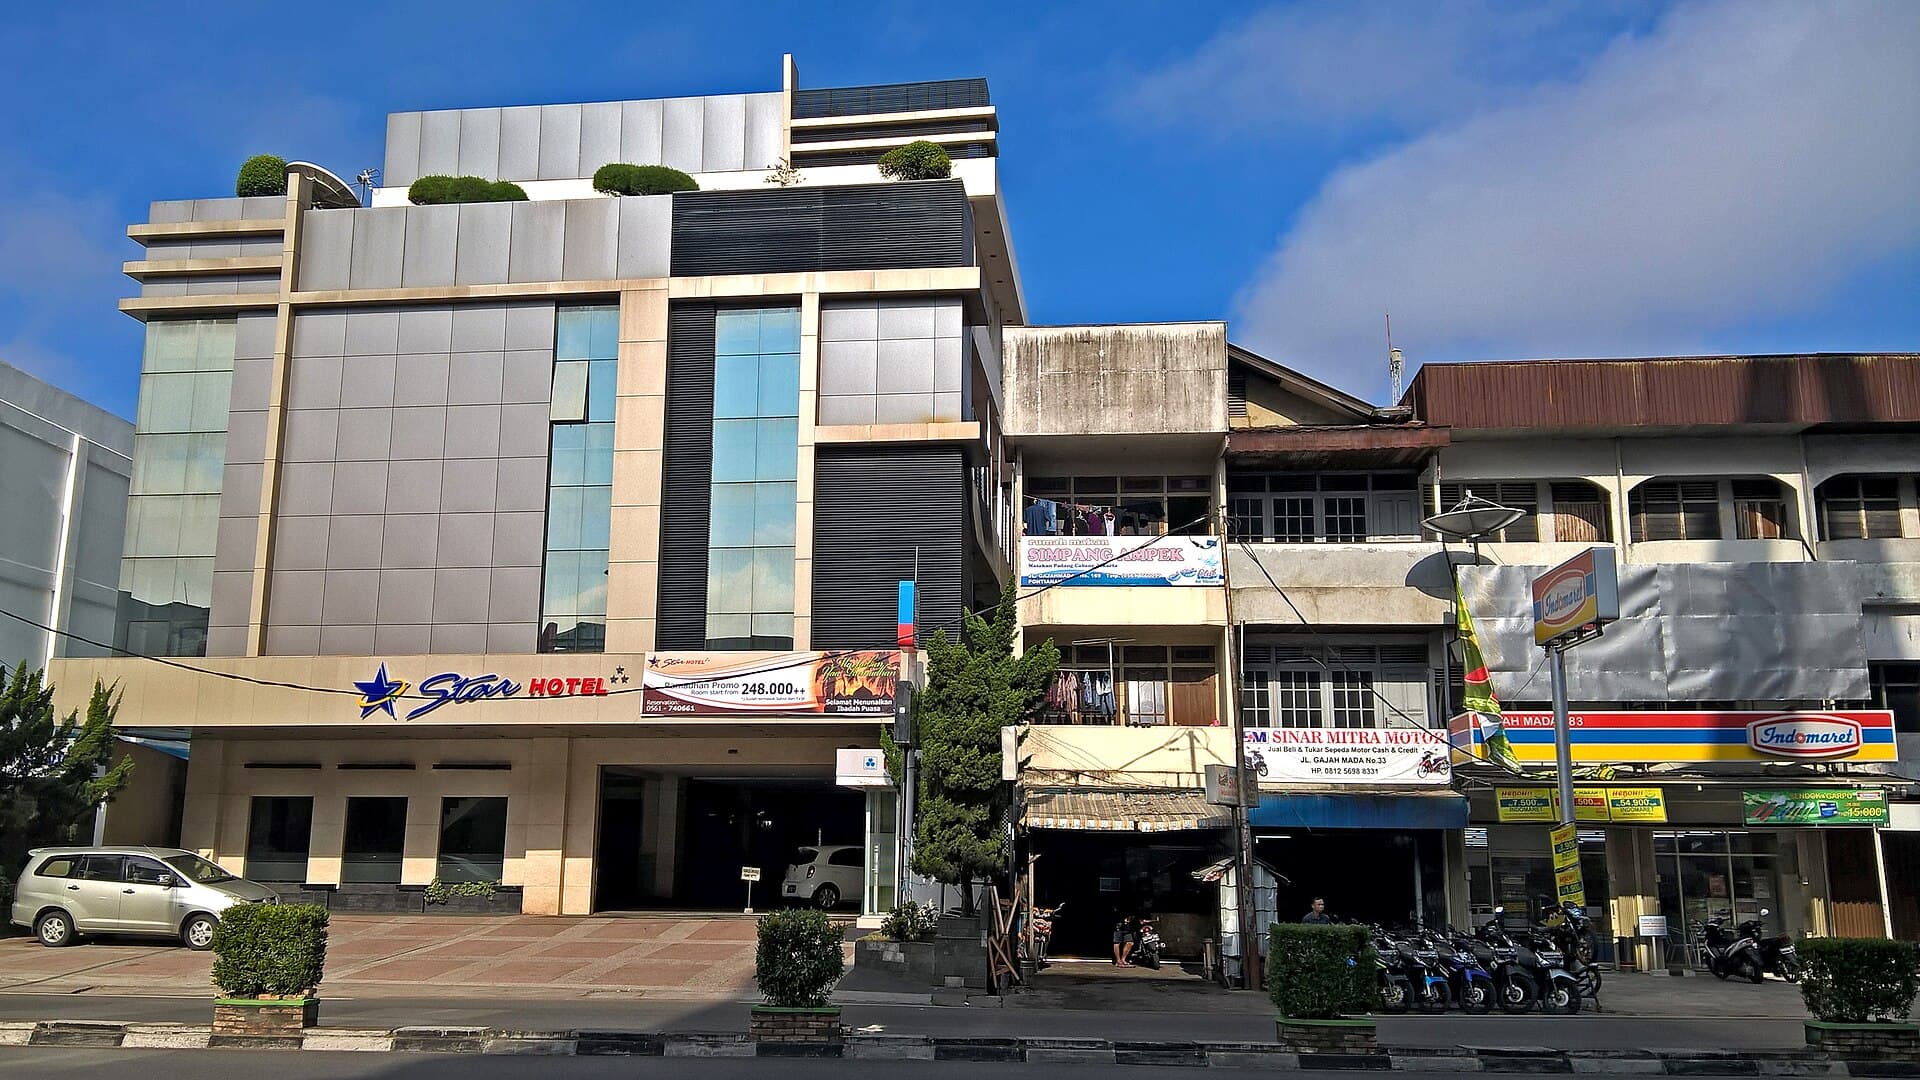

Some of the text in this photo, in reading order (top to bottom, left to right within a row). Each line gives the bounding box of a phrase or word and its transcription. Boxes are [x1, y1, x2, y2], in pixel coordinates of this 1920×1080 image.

[1028, 547, 1185, 562] SIMPANG AMPEK
[711, 681, 740, 689] Promo
[404, 672, 608, 721] Star HOTEL
[1502, 716, 1520, 726] AH
[1568, 716, 1584, 726] 83
[1272, 730, 1323, 744] SINAR
[1327, 731, 1380, 744] MITRA
[1384, 731, 1445, 744] MOTOR
[1760, 726, 1854, 744] Indomaret
[1300, 756, 1311, 764] JL.
[1313, 756, 1340, 764] GAJAH
[1341, 756, 1364, 764] MADA
[1311, 767, 1323, 775] HP.
[1324, 767, 1342, 775] 0812
[1343, 767, 1361, 775] 5698
[1619, 799, 1649, 807] 54.900
